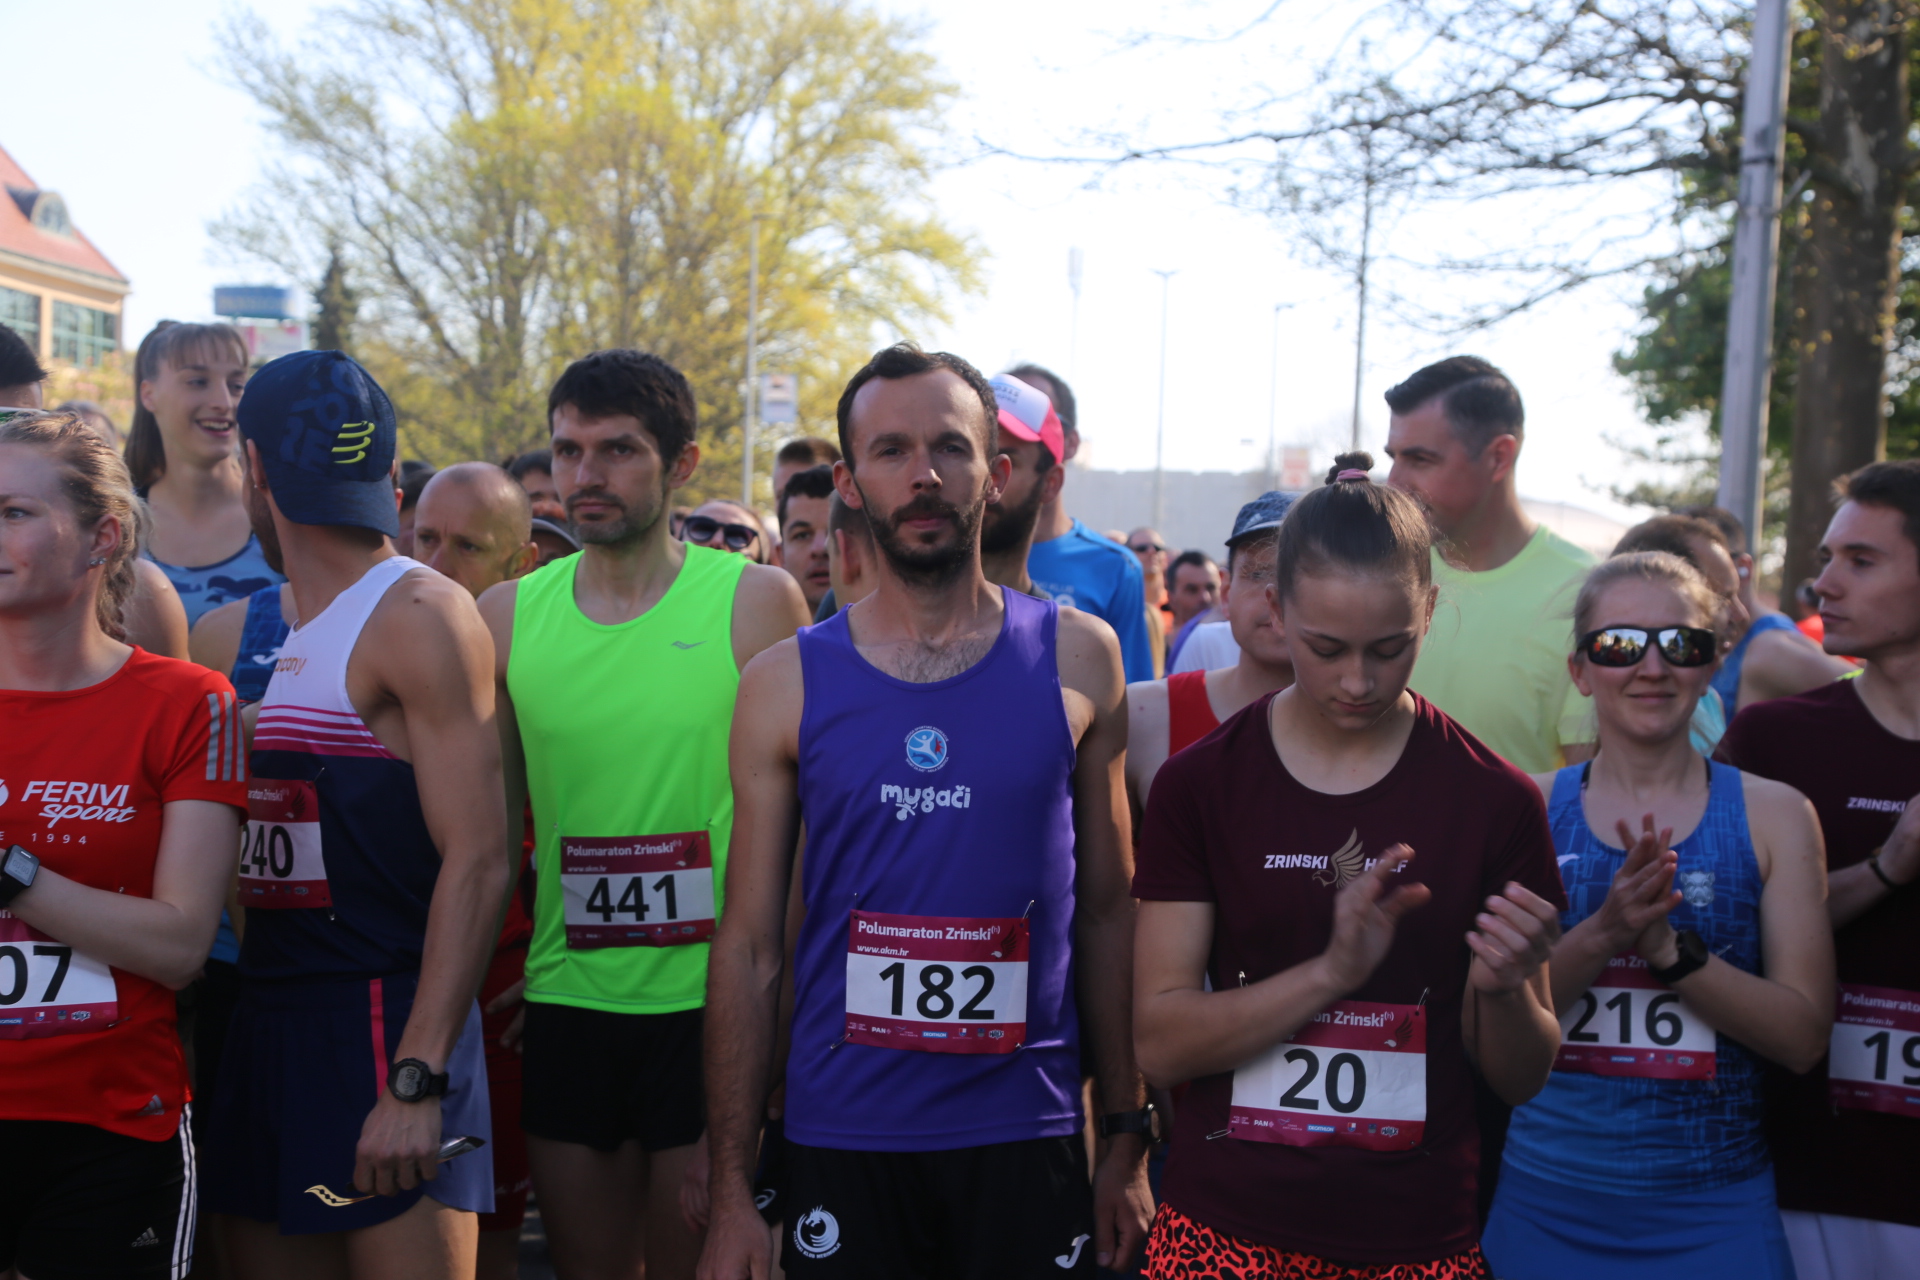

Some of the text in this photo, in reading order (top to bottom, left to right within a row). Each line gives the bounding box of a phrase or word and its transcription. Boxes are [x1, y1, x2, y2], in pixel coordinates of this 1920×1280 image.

[21, 781, 130, 807] FERIVI
[881, 784, 970, 820] mugači
[1847, 796, 1906, 812] ZRINSKI
[38, 803, 138, 829] sport
[240, 822, 294, 878] 240
[566, 844, 632, 857] Polumaraton
[1264, 853, 1409, 873] ZRINSKI HF
[586, 873, 678, 923] 441
[858, 920, 943, 940] Polumaraton
[856, 944, 910, 957] www.akm.hr
[0, 944, 73, 1006] 07
[878, 961, 996, 1021] 182
[1567, 990, 1684, 1047] 216
[1279, 1047, 1367, 1114] 20
